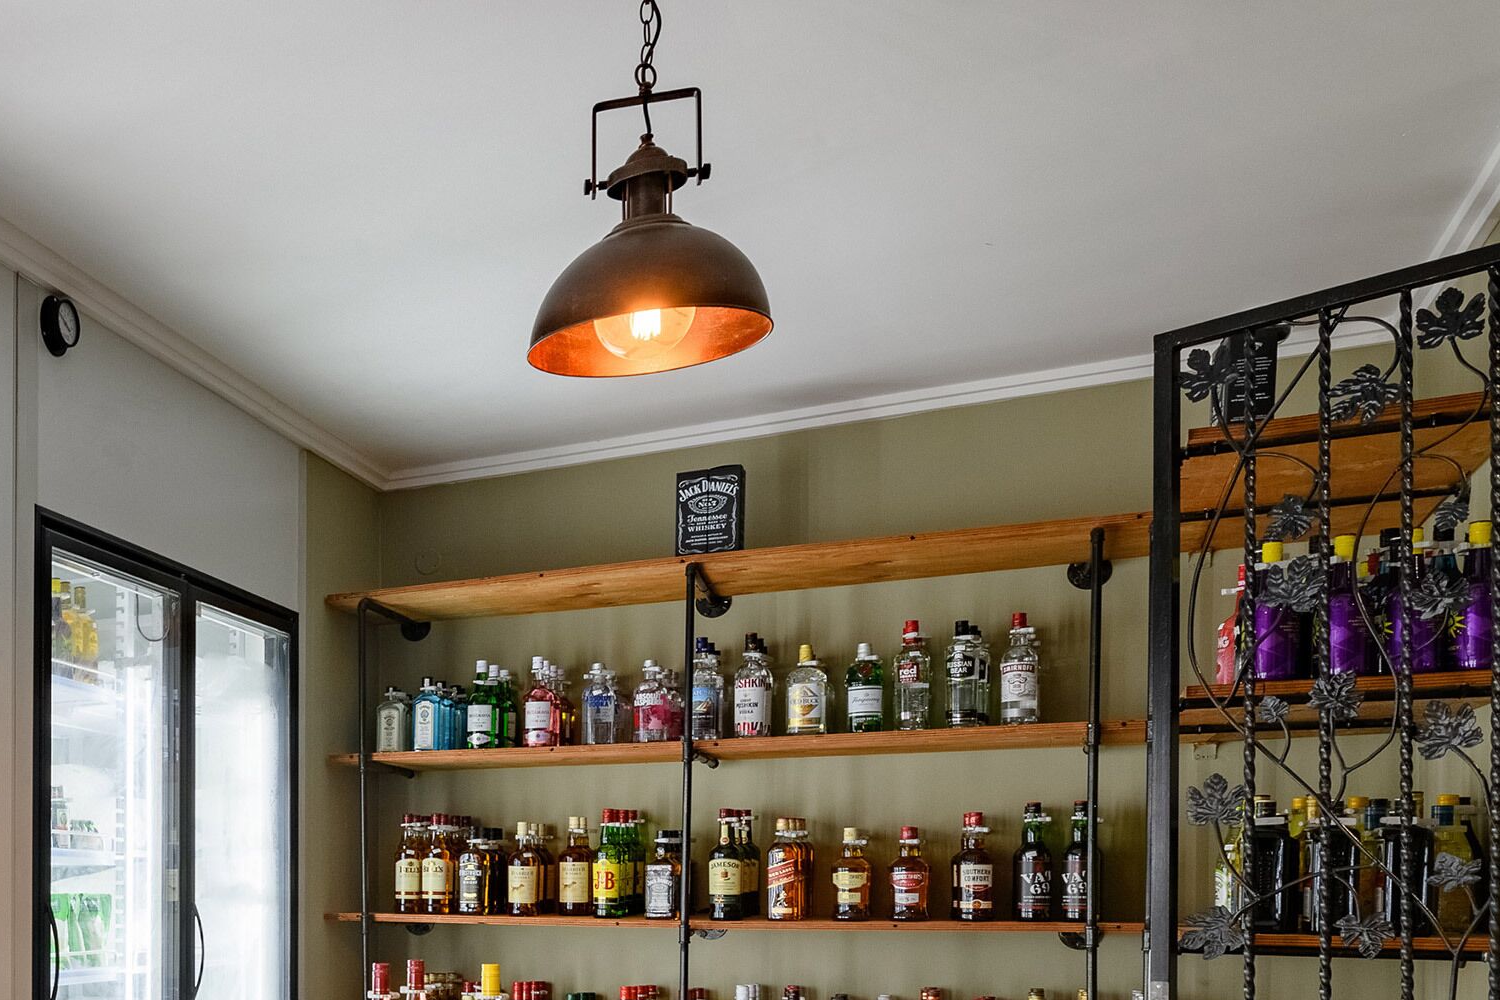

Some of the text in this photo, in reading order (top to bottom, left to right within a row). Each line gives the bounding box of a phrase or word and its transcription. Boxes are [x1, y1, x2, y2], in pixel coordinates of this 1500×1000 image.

[678, 484, 702, 503] JACK
[686, 513, 728, 524] Tennessee
[899, 665, 917, 675] red
[1003, 665, 1034, 675] SMIRNOFF
[710, 861, 740, 870] JAMESON
